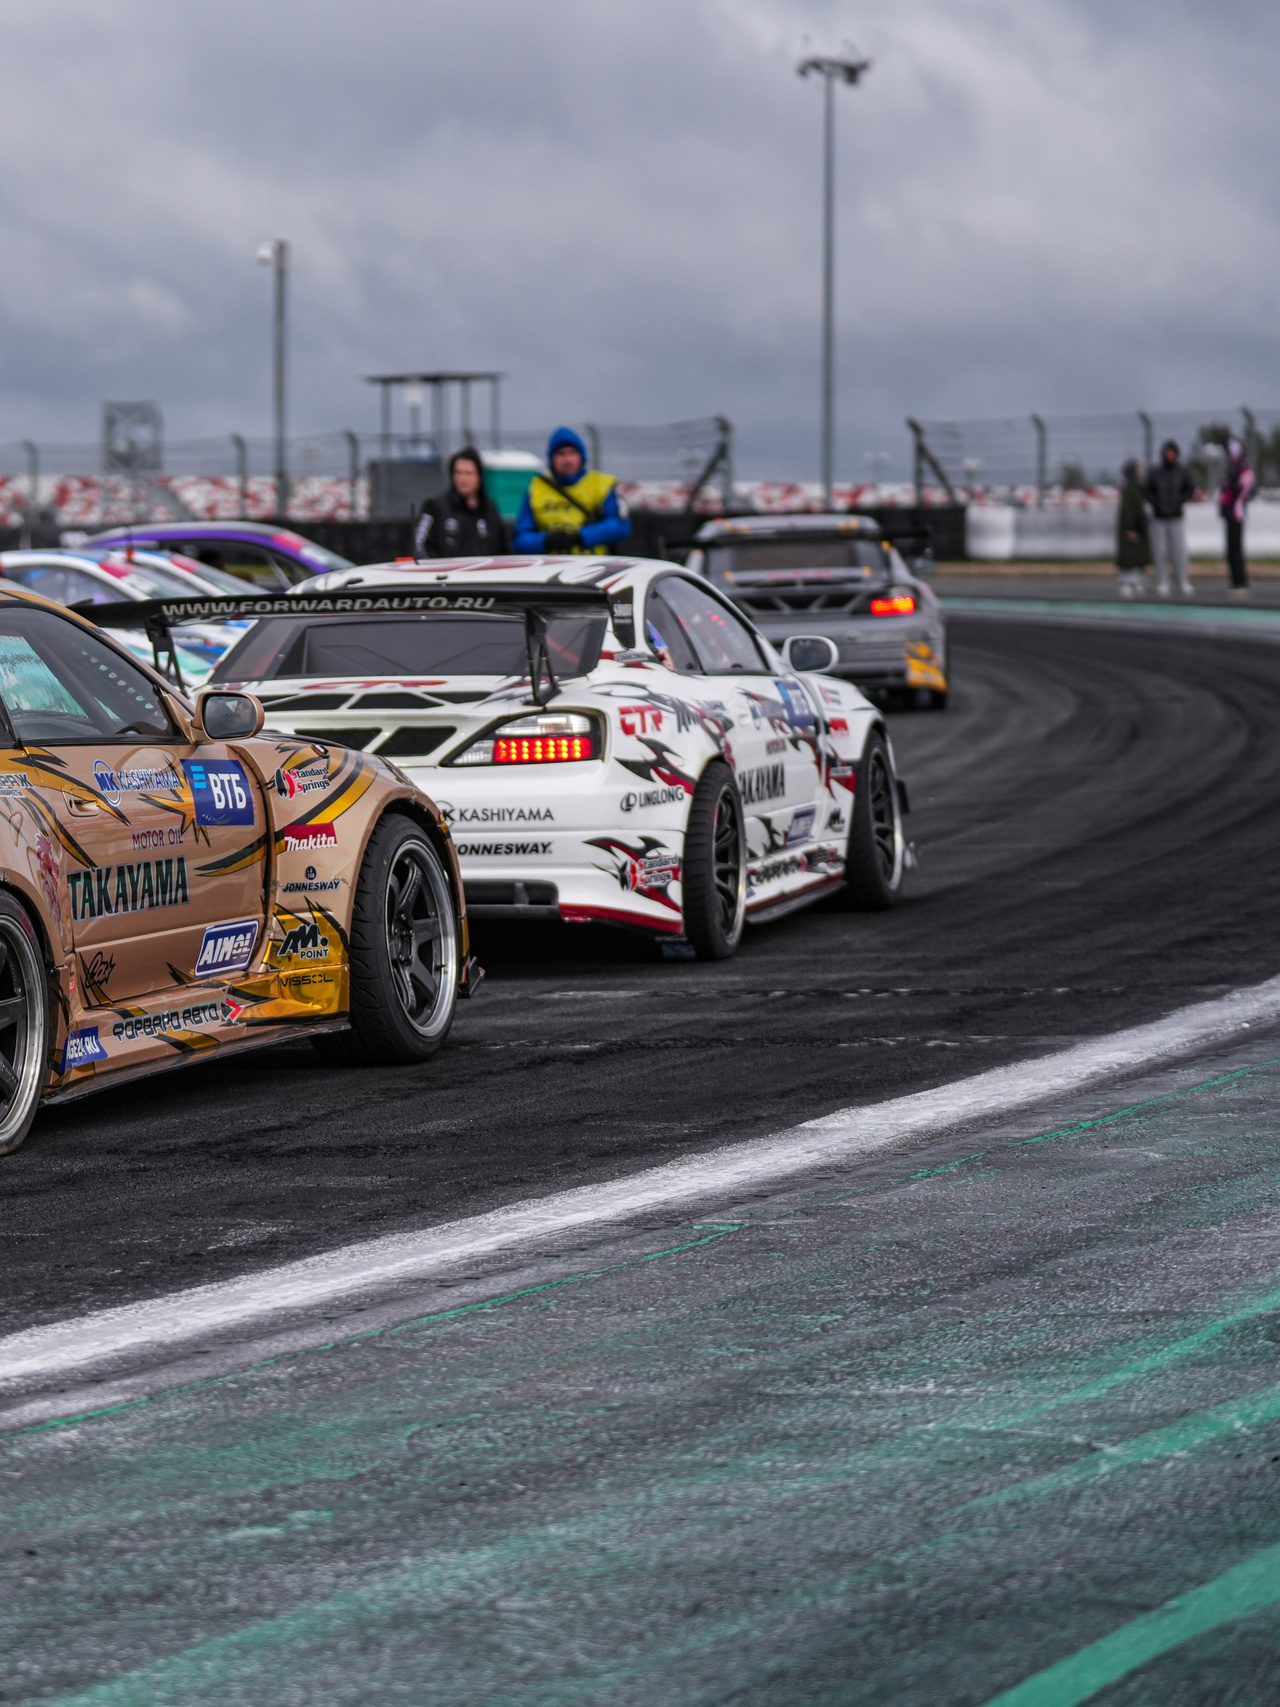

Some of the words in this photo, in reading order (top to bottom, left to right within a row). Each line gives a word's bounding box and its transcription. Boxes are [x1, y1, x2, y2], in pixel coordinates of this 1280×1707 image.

[162, 597, 495, 616] WWW.FORWARDAUTO.RU
[117, 769, 183, 791] KASHIYAMA
[292, 767, 329, 779] Standard
[208, 773, 246, 809] ВТБ
[297, 780, 330, 793] Springs
[639, 787, 684, 807] LINGLONG
[460, 808, 554, 821] KASHIYAMA
[132, 829, 165, 850] MOTOR
[168, 827, 183, 845] OIL
[454, 842, 552, 855] ONNESWAY
[67, 857, 189, 920] TAKAYAMA
[283, 881, 340, 892] JONNESWAY
[199, 933, 252, 966] AIMOL
[301, 949, 328, 959] POINT
[280, 974, 334, 987] VISSOL
